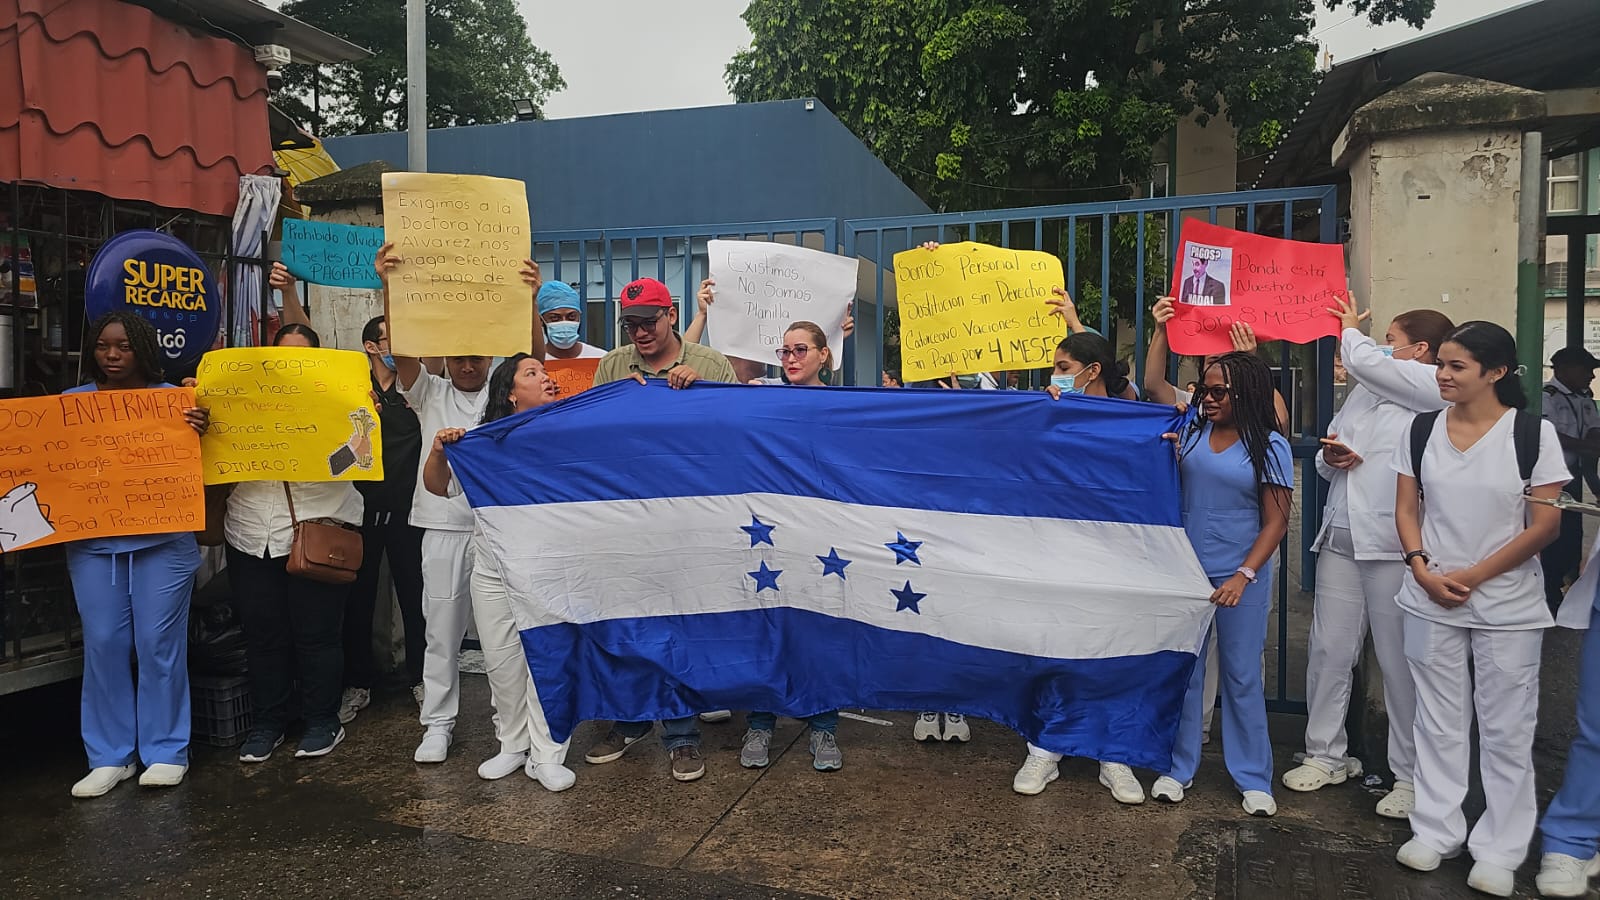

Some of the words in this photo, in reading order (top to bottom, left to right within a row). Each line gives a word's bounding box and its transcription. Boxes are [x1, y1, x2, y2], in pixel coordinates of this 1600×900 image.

[398, 192, 470, 213] Exigimos
[479, 201, 489, 211] a
[497, 201, 511, 215] la
[287, 223, 338, 243] Prohibido
[347, 231, 383, 247] Olvida
[400, 215, 469, 230] Doctora
[474, 218, 520, 236] Yadira
[401, 236, 471, 248] Alvarez
[480, 240, 511, 250] nos
[1191, 245, 1221, 260] PAGOS?
[288, 244, 296, 263] Y
[301, 253, 317, 263] se
[323, 248, 343, 263] les
[401, 253, 446, 269] haga
[454, 254, 518, 268] efectivo
[123, 258, 206, 294] SUPER
[898, 259, 944, 281] Somos
[955, 254, 1020, 280] Personal
[1030, 261, 1047, 271] en
[402, 271, 419, 284] el
[430, 272, 474, 286] pago
[483, 271, 505, 284] de
[738, 276, 755, 295] No
[765, 281, 812, 301] Somos
[1236, 278, 1294, 292] Nuestro
[125, 285, 207, 312] RECARGA
[903, 292, 965, 320] Sustitucion
[971, 293, 991, 306] sin
[995, 279, 1046, 302] Derecho
[1274, 289, 1345, 305] DINERO
[744, 301, 790, 320] Planilla
[1179, 312, 1232, 336] Son
[1239, 306, 1257, 324] 8
[1264, 304, 1326, 325] MESE
[962, 317, 1022, 337] Vaciones
[1028, 310, 1048, 327] etc
[758, 324, 785, 345] Fant
[927, 348, 959, 370] Pago
[962, 348, 983, 369] por
[989, 337, 1003, 363] 4
[220, 360, 253, 373] nos
[261, 359, 329, 376] pagan
[197, 383, 247, 398] desde
[256, 380, 302, 394] hace
[59, 392, 193, 427] ENFERMERA
[211, 421, 264, 434] Donde
[43, 440, 69, 452] no
[80, 431, 165, 450] significa
[232, 440, 289, 451] Nuestro
[0, 468, 36, 486] que
[46, 457, 112, 476] trabaje
[123, 472, 201, 491] esperando
[88, 494, 109, 505] mi
[59, 514, 98, 533] Sra
